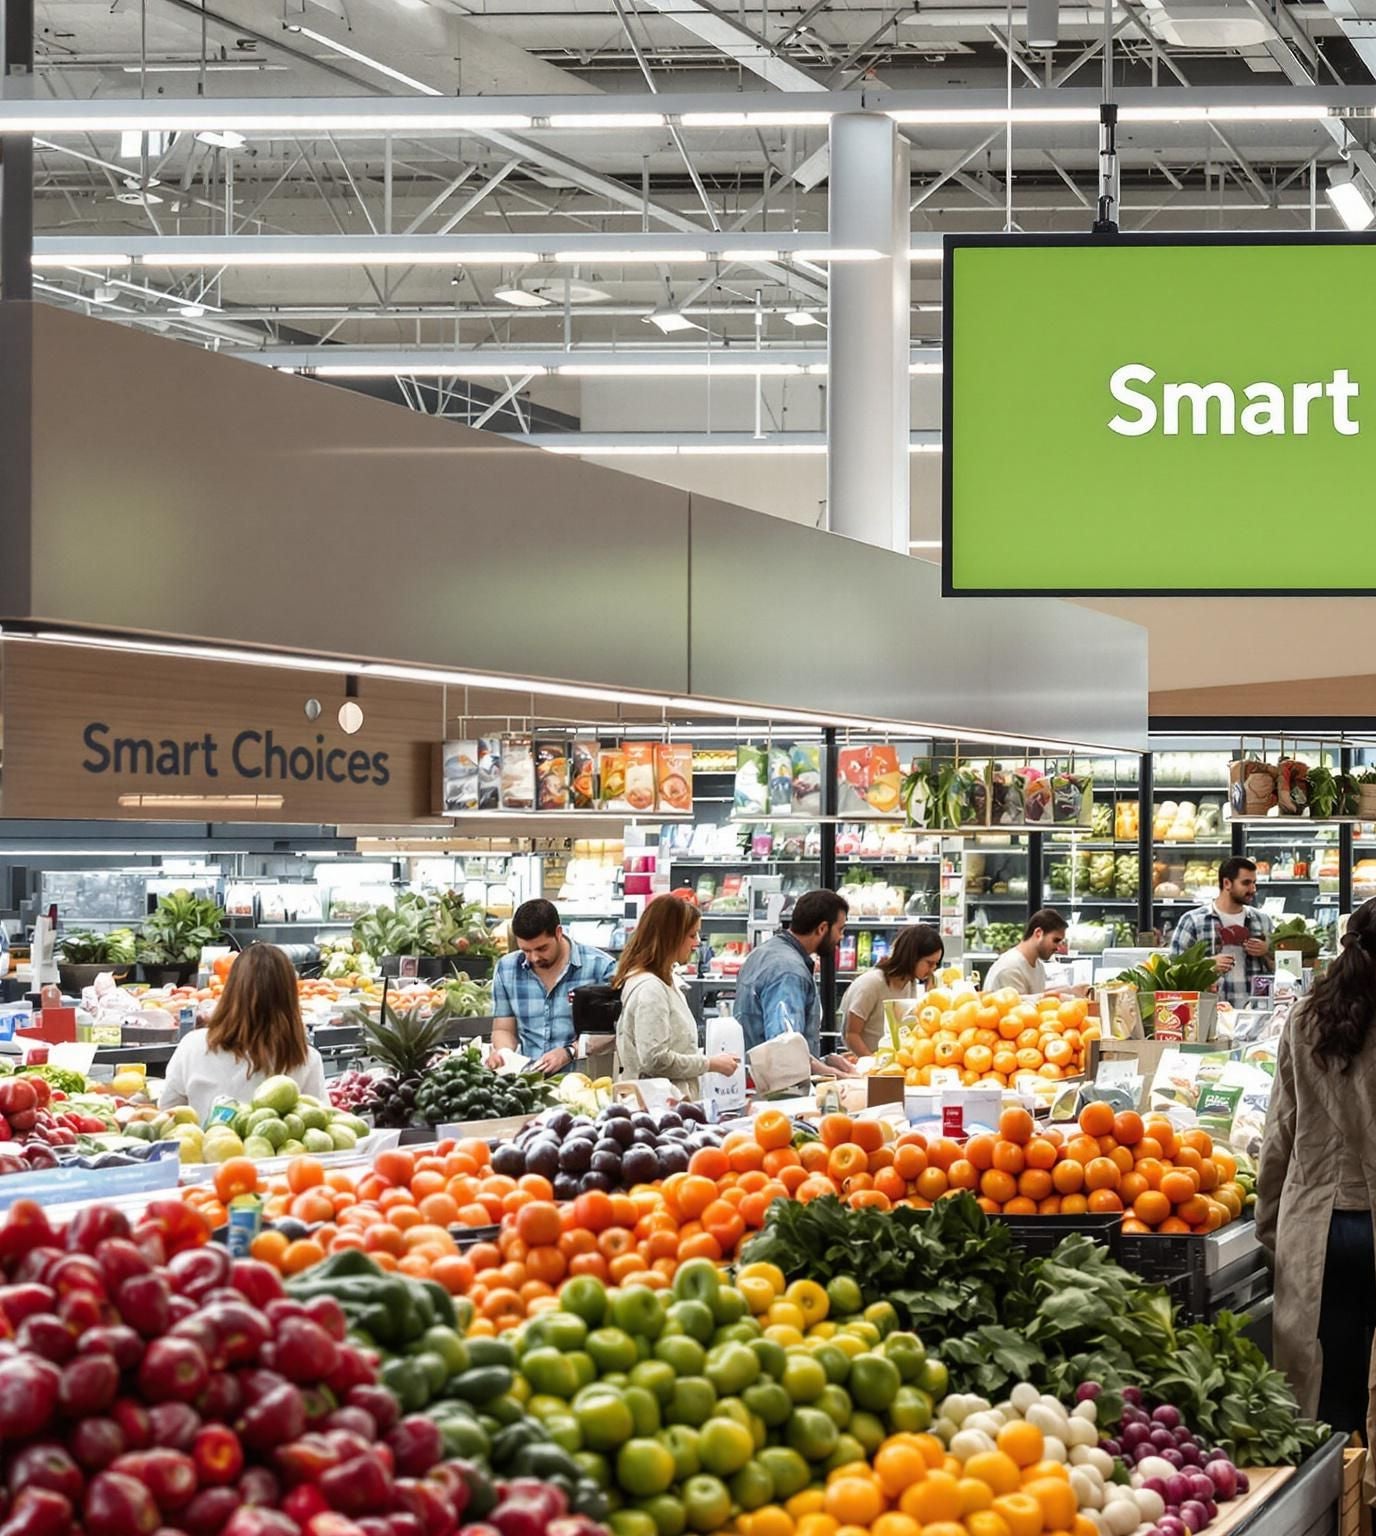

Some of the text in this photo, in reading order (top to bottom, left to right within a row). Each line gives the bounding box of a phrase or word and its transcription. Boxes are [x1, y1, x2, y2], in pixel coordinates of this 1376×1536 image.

[1107, 363, 1360, 436] Smart
[82, 722, 390, 786] Smart Choices
